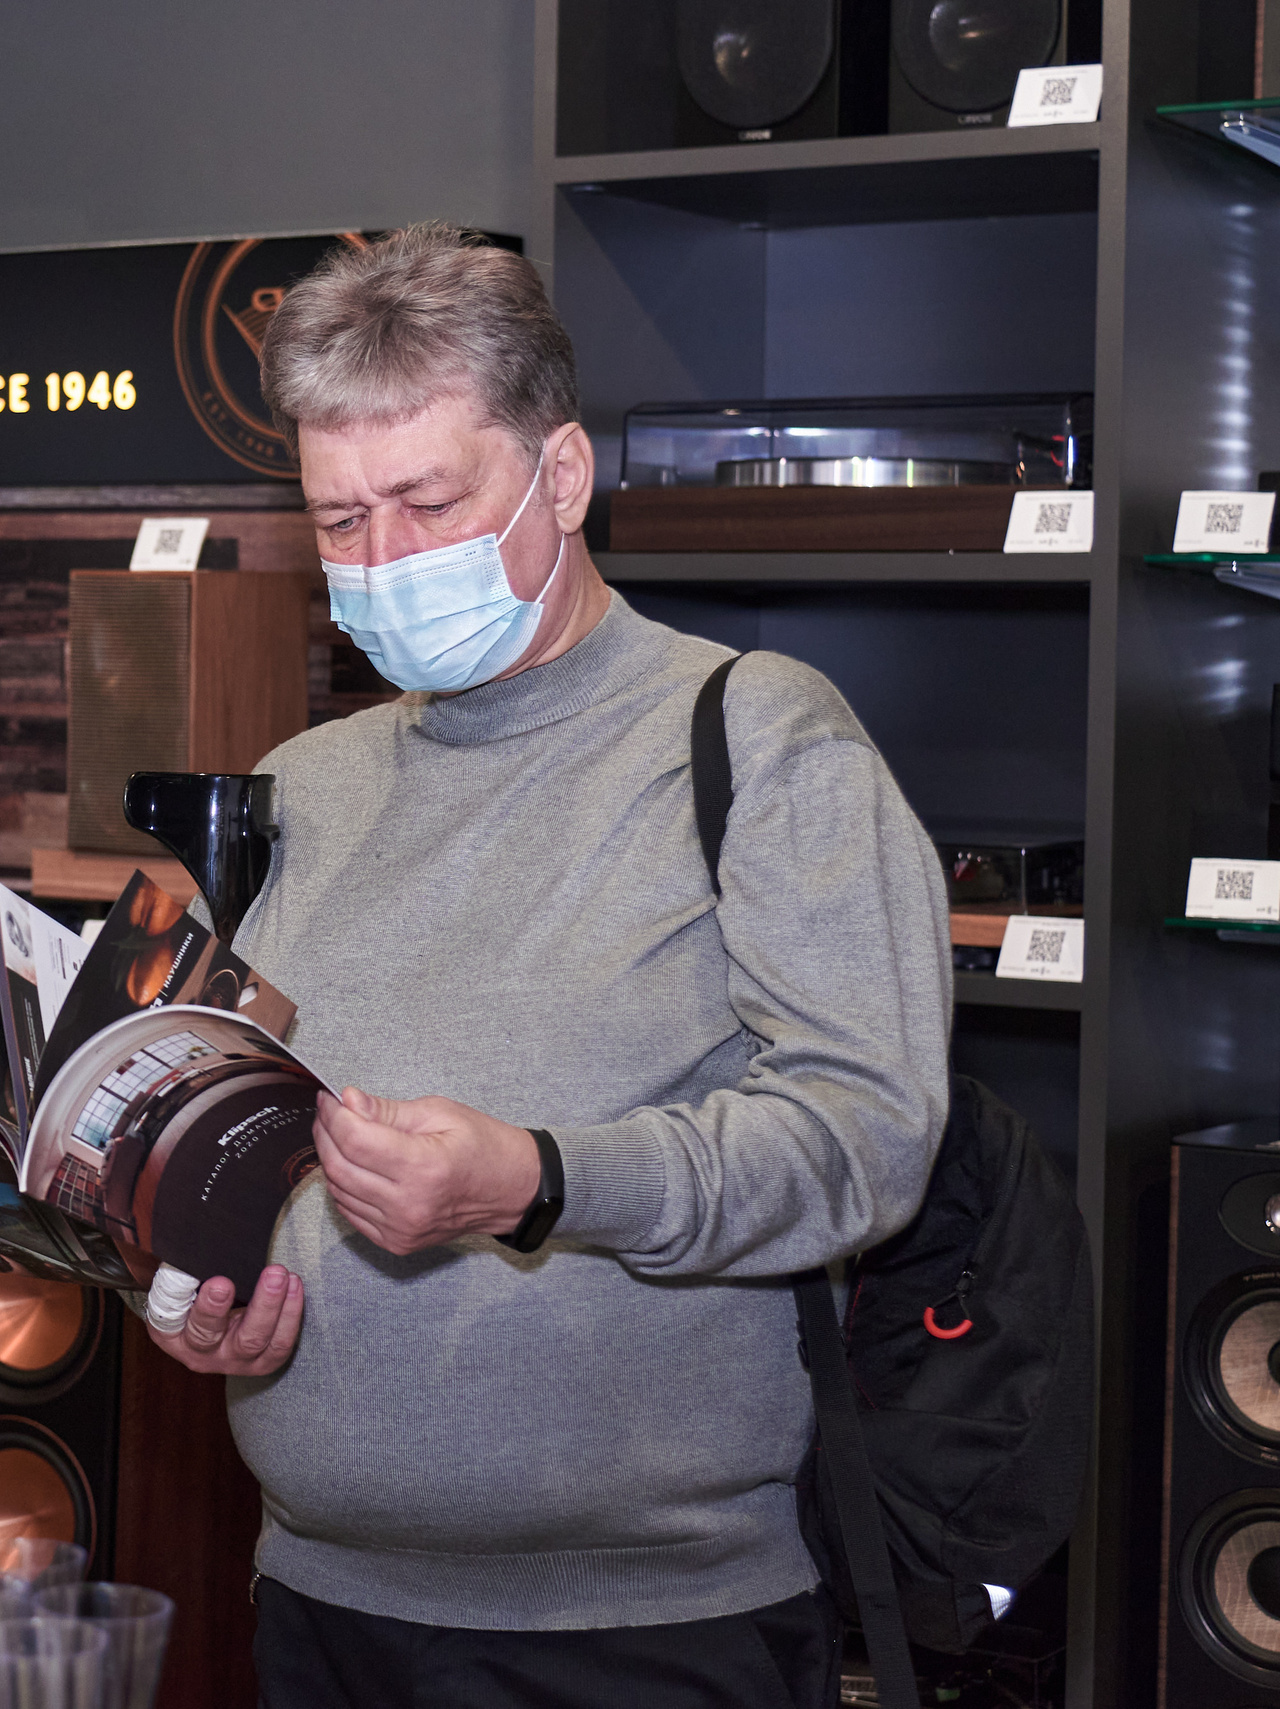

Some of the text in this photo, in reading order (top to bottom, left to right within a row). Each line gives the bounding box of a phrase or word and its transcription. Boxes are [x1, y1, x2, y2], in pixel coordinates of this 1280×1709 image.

[45, 370, 136, 412] 1946
[163, 932, 194, 988] НАУШНИКИ
[218, 1106, 279, 1146] Klipsch
[235, 1136, 259, 1159] 2020
[272, 1116, 298, 1129] 2021
[201, 1108, 300, 1201] КАТАЛОГ ДОМАШНЕГО
